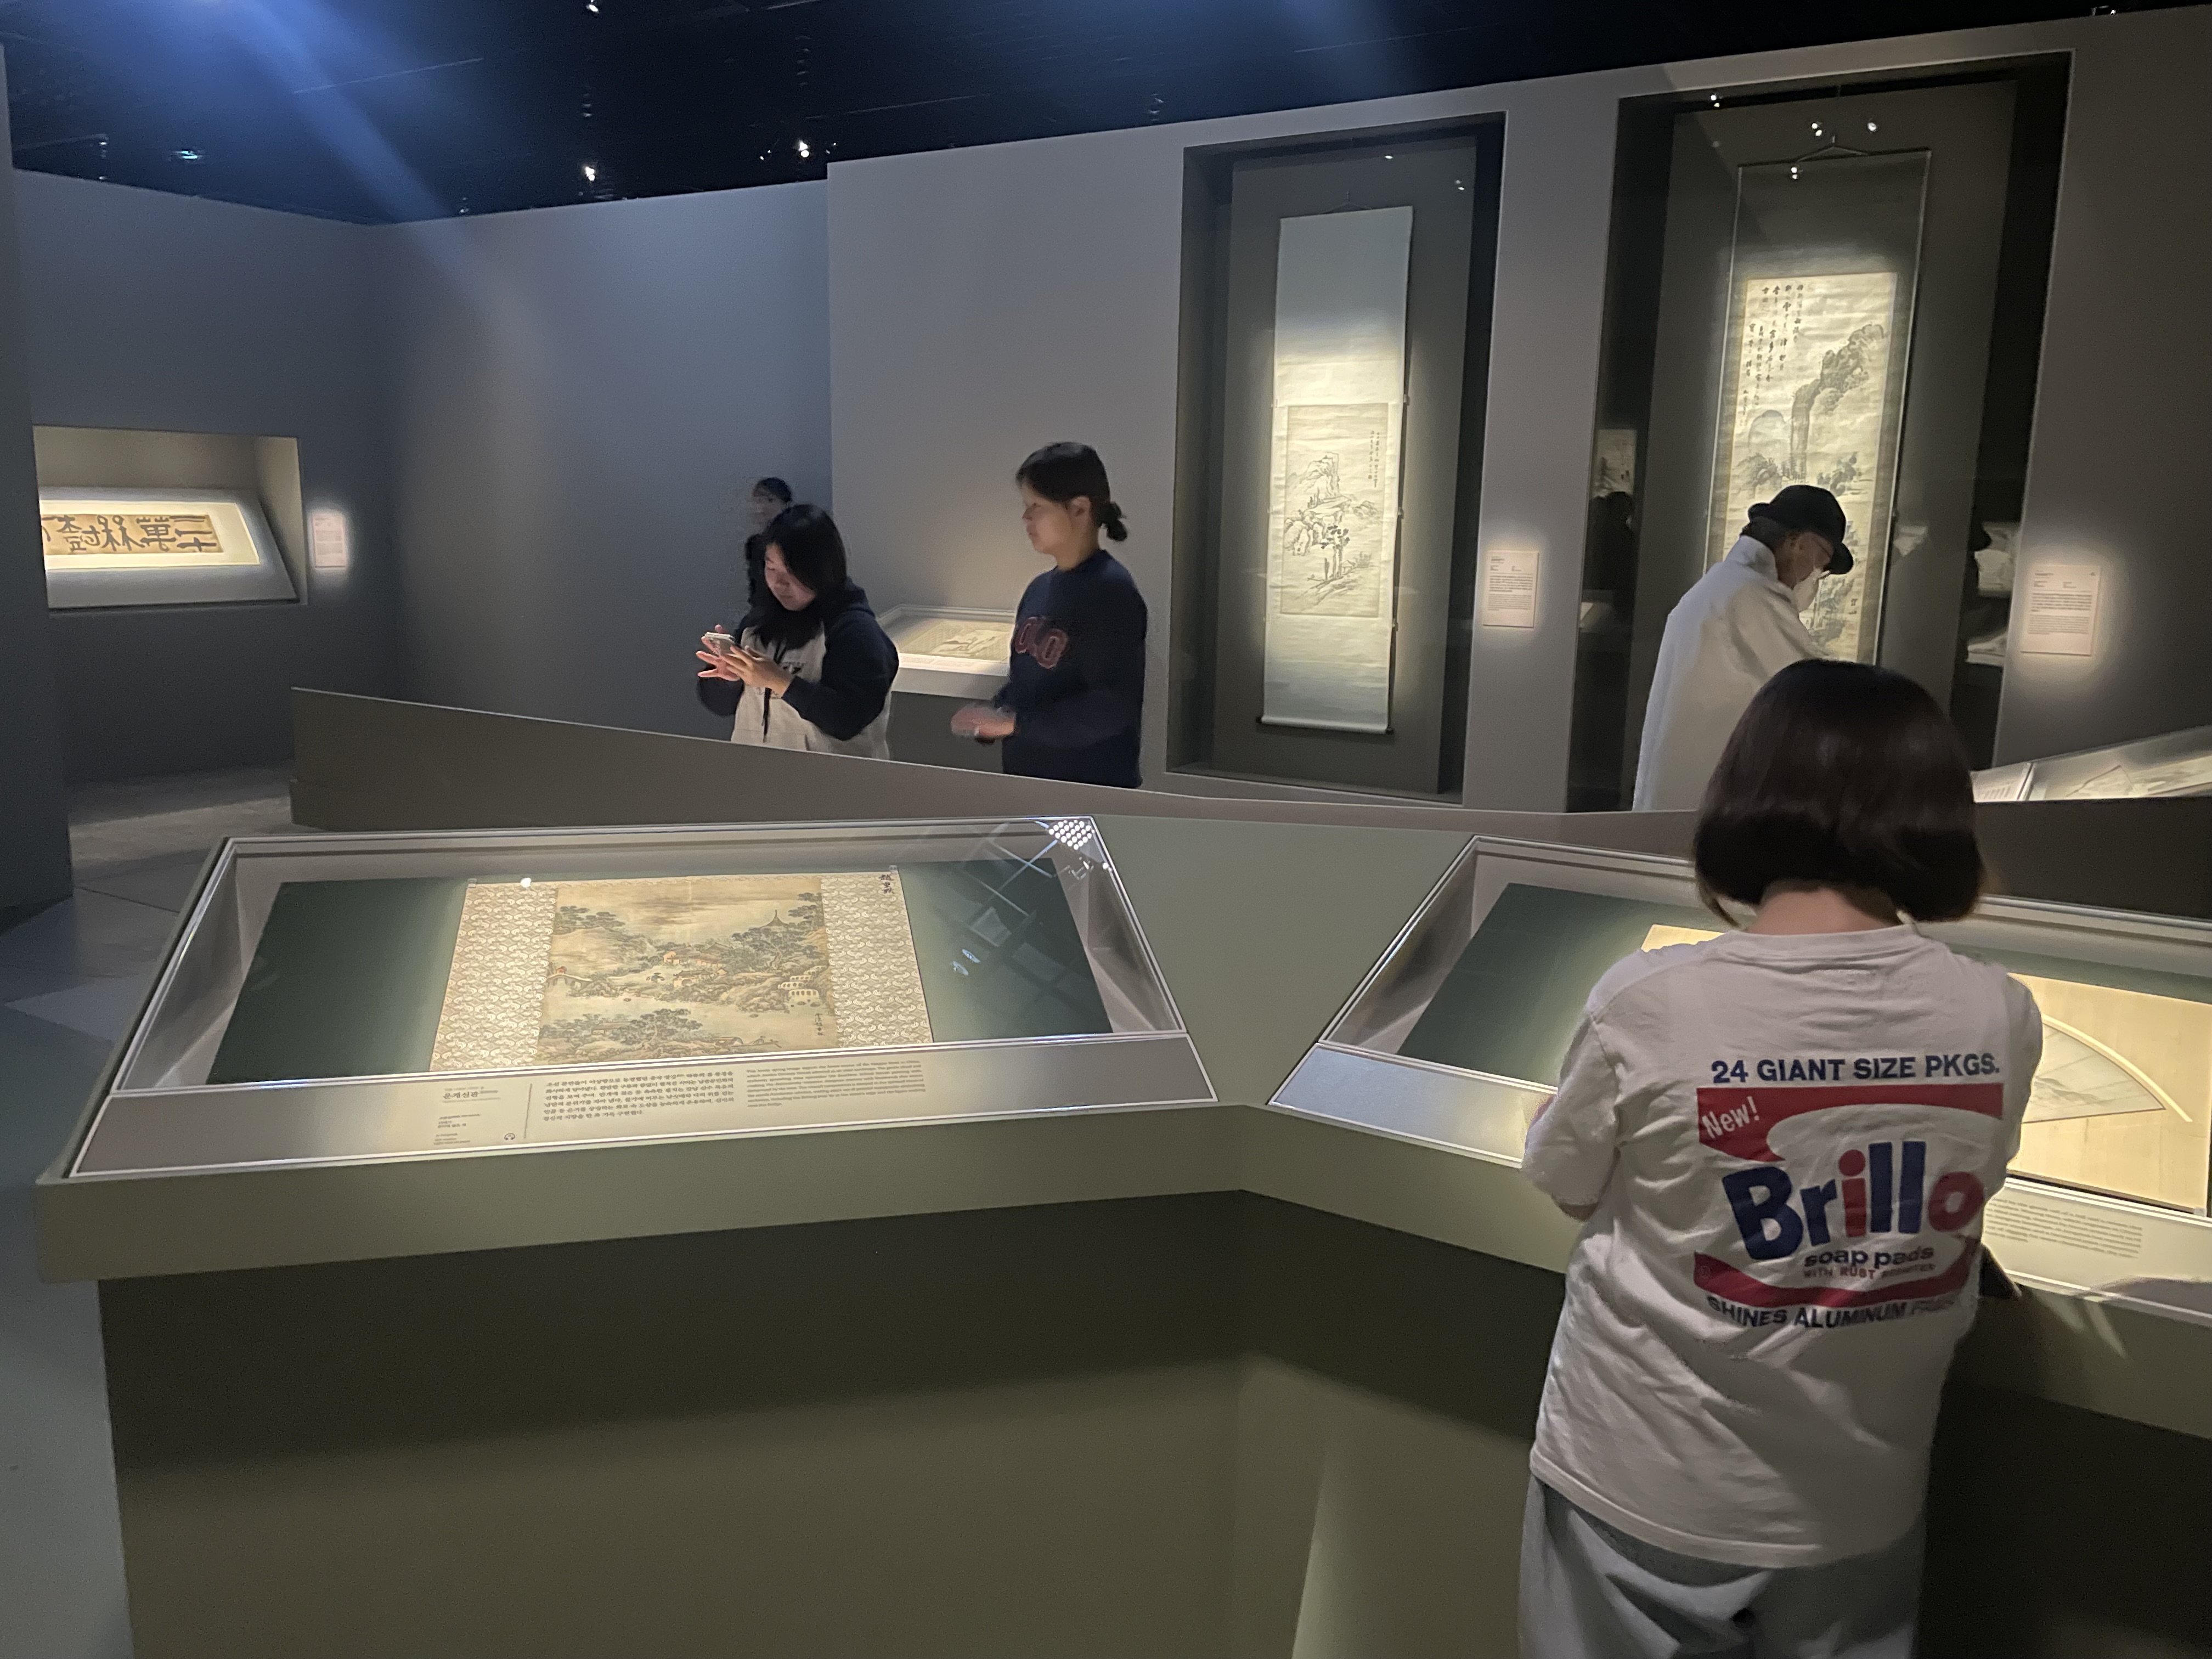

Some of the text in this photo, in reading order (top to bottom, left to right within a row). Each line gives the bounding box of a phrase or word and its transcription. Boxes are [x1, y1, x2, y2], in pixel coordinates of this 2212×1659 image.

[1712, 1053, 2000, 1084] 24 GIANT SIZE PKGS.
[1702, 1096, 1760, 1139] New!
[1722, 1141, 1985, 1260] Brillo
[1804, 1246, 1934, 1268] soap pads
[1706, 1295, 1787, 1327] SHINES
